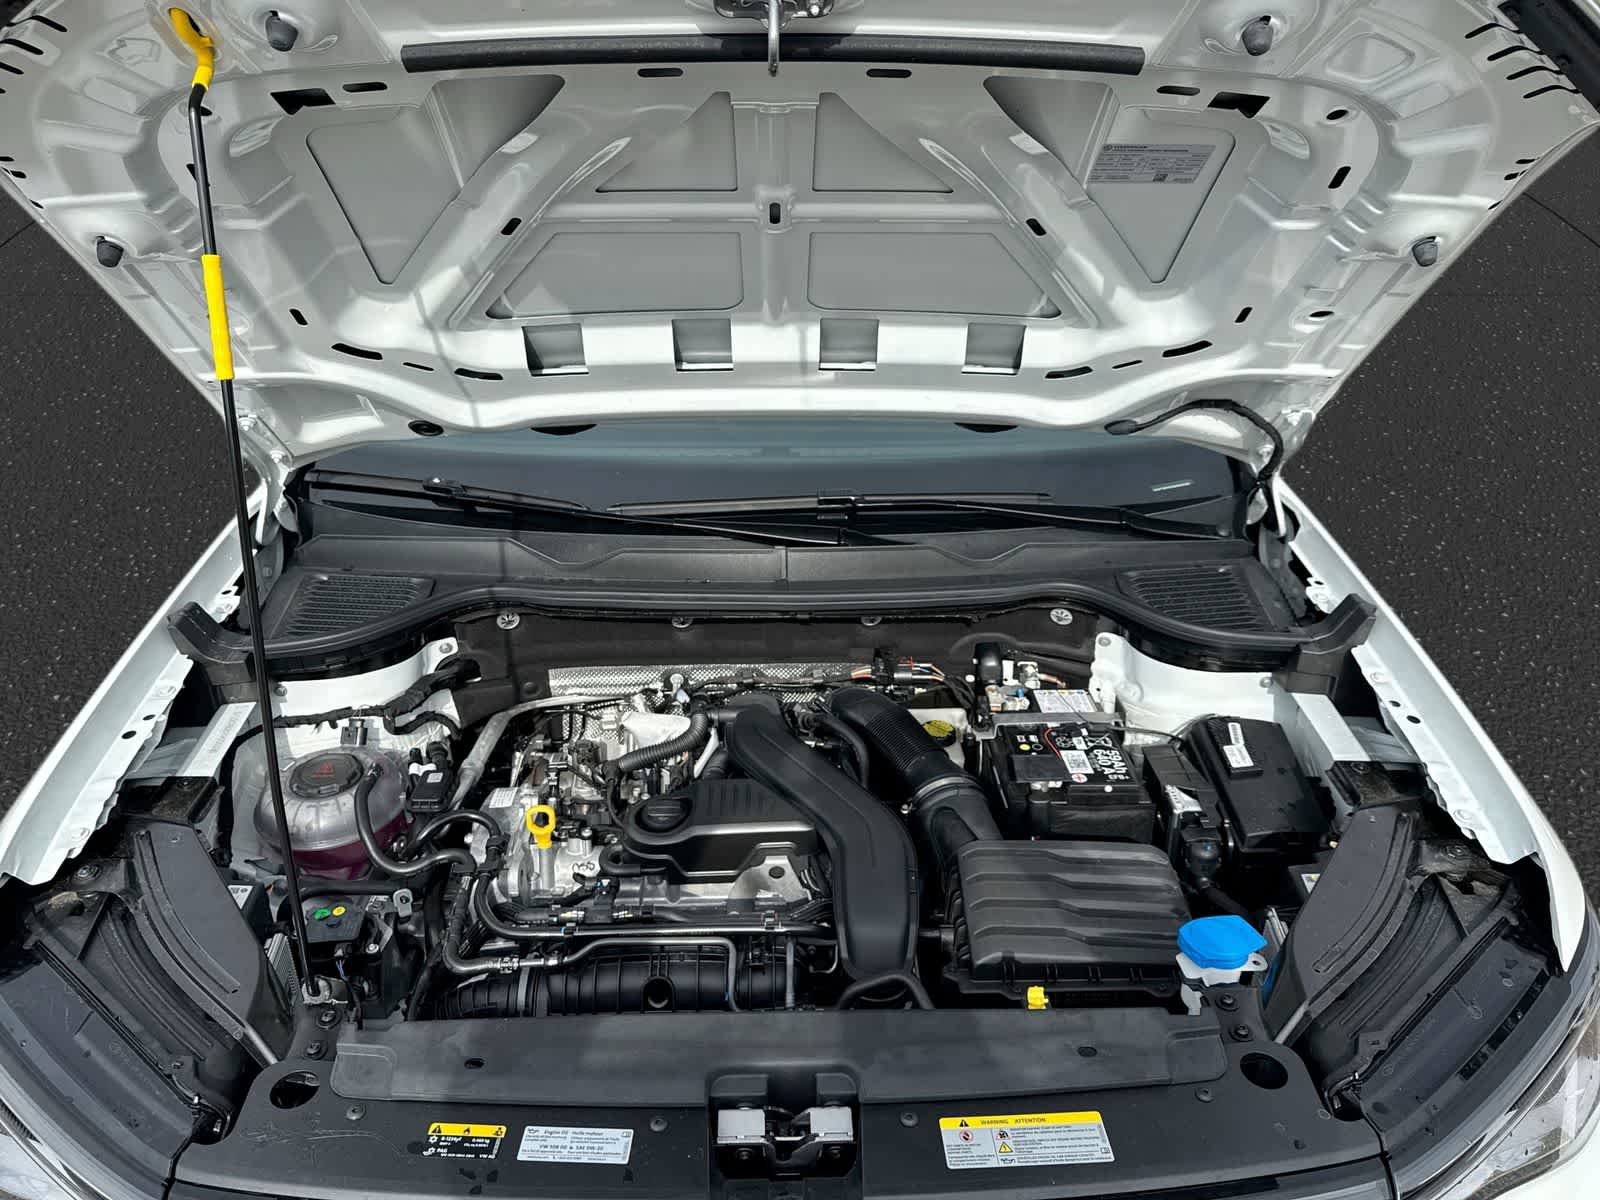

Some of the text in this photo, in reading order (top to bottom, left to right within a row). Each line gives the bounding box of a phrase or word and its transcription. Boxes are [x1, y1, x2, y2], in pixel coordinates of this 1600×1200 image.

[1093, 749, 1112, 766] 640
[1106, 750, 1128, 774] 59Ah
[1102, 767, 1116, 775] A
